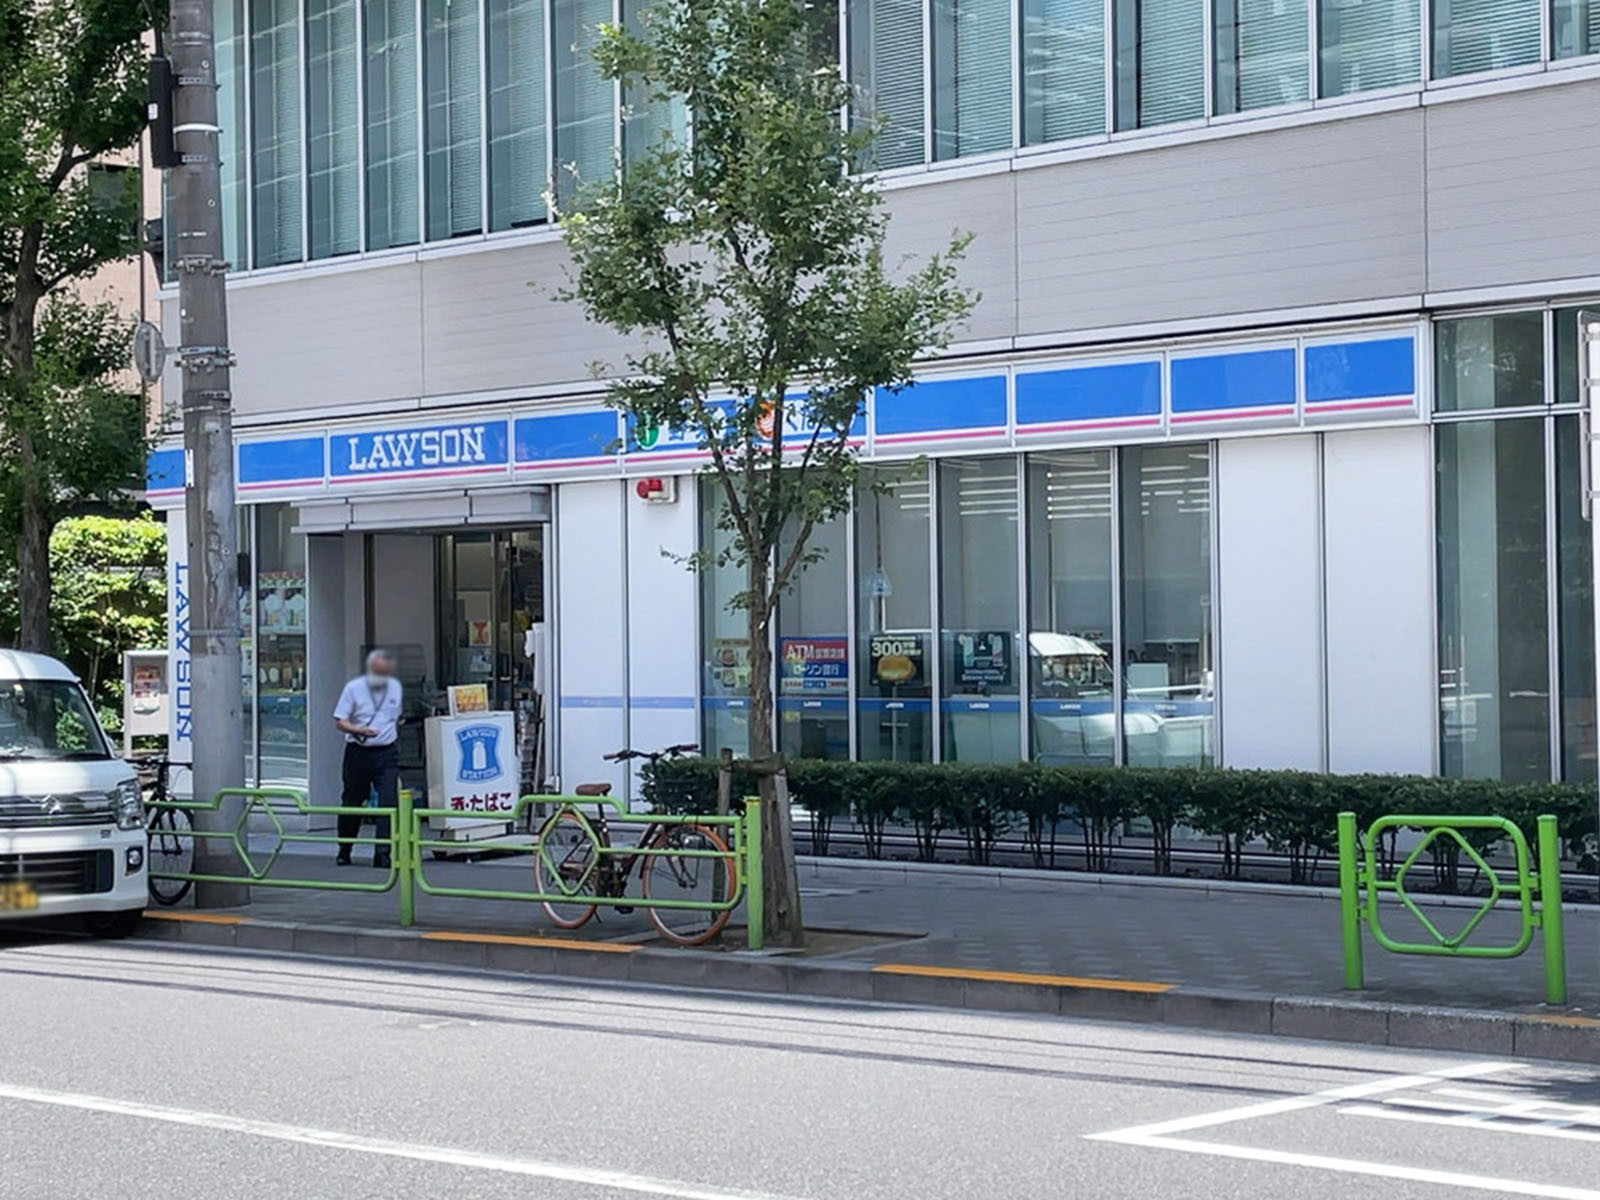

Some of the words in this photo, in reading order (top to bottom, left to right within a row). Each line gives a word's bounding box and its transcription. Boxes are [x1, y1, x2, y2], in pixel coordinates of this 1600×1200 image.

[349, 426, 486, 471] LAWSON
[175, 561, 192, 742] LAWSON
[786, 644, 814, 661] ATM
[871, 641, 902, 657] 300
[459, 728, 497, 742] LAWSON
